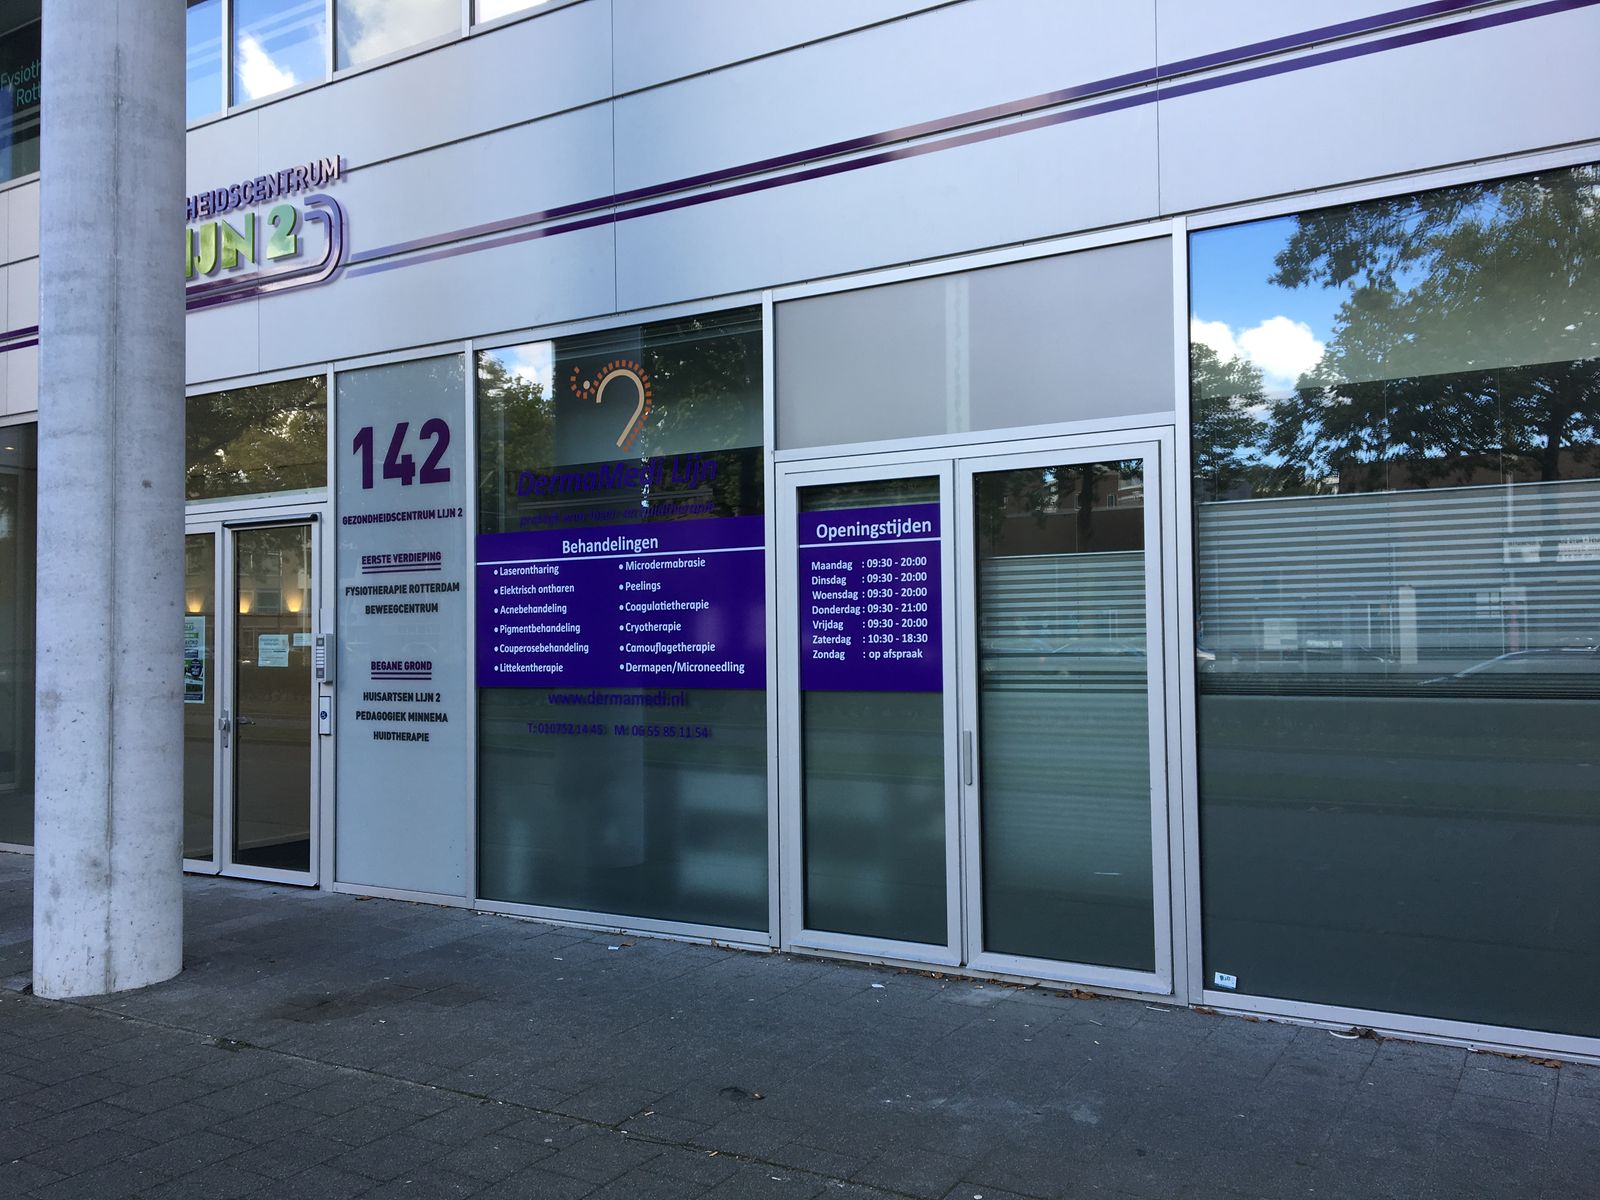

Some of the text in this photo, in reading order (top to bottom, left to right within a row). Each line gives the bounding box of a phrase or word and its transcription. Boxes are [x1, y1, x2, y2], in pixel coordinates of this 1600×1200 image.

[186, 155, 340, 220] HEIDSCENTRUM
[267, 204, 297, 260] 2
[353, 418, 450, 489] 142
[342, 508, 462, 525] GEZONDHEIDSCENTRUM LIJN 2
[816, 518, 932, 541] Openingstijden
[563, 535, 658, 553] Behandelingen
[362, 552, 441, 564] EERSTE VERDIEPING
[812, 560, 852, 571] Maandag
[867, 558, 892, 568] 09:30
[901, 556, 927, 566] 20:00
[500, 565, 559, 576] Laserontharing
[625, 558, 705, 571] Microdermabrasie
[812, 575, 846, 586] Dinsdag
[867, 573, 892, 583] 09:30
[901, 572, 927, 581] 20:00
[345, 582, 459, 596] FYSIOTHERAPIE ROTTERDAM
[500, 583, 574, 595] Elektrisch ontharen
[625, 580, 661, 592] Peelings
[812, 590, 858, 600] Woensdag
[867, 589, 893, 598] 09:30
[901, 587, 927, 597] 20:00
[365, 603, 438, 614] BEWEEGCENTRUM
[500, 603, 567, 615] Acnebehandeling
[625, 600, 709, 612] Coagulatietherapie
[812, 604, 860, 615] Donderdag
[868, 604, 893, 613] 09:30
[901, 602, 927, 612] 21:00
[500, 623, 580, 635] Pigmentbehandeling
[625, 621, 681, 633] Cryotherapie
[813, 620, 843, 630] Vrijdag
[868, 619, 893, 628] 09:30
[901, 618, 928, 627] 20:00
[813, 635, 851, 645] Zaterdag
[868, 634, 893, 643] 10:30
[902, 633, 928, 642] 18:30
[500, 643, 589, 654] Couperosebehandeling
[625, 642, 715, 653] Camouflagetherapie
[813, 650, 845, 660] Zondag
[869, 651, 880, 660] op
[883, 649, 923, 660] afspraak
[371, 661, 432, 670] BEGANE GROND
[500, 663, 563, 674] Littekentherapie
[625, 661, 745, 674] Dermapen/Microneedling
[363, 692, 440, 702] HUISARTSEN LIJN 2
[356, 711, 448, 722] PEDAGOGIEK MINNEMA
[373, 731, 429, 741] HUIDTHERAPIE
